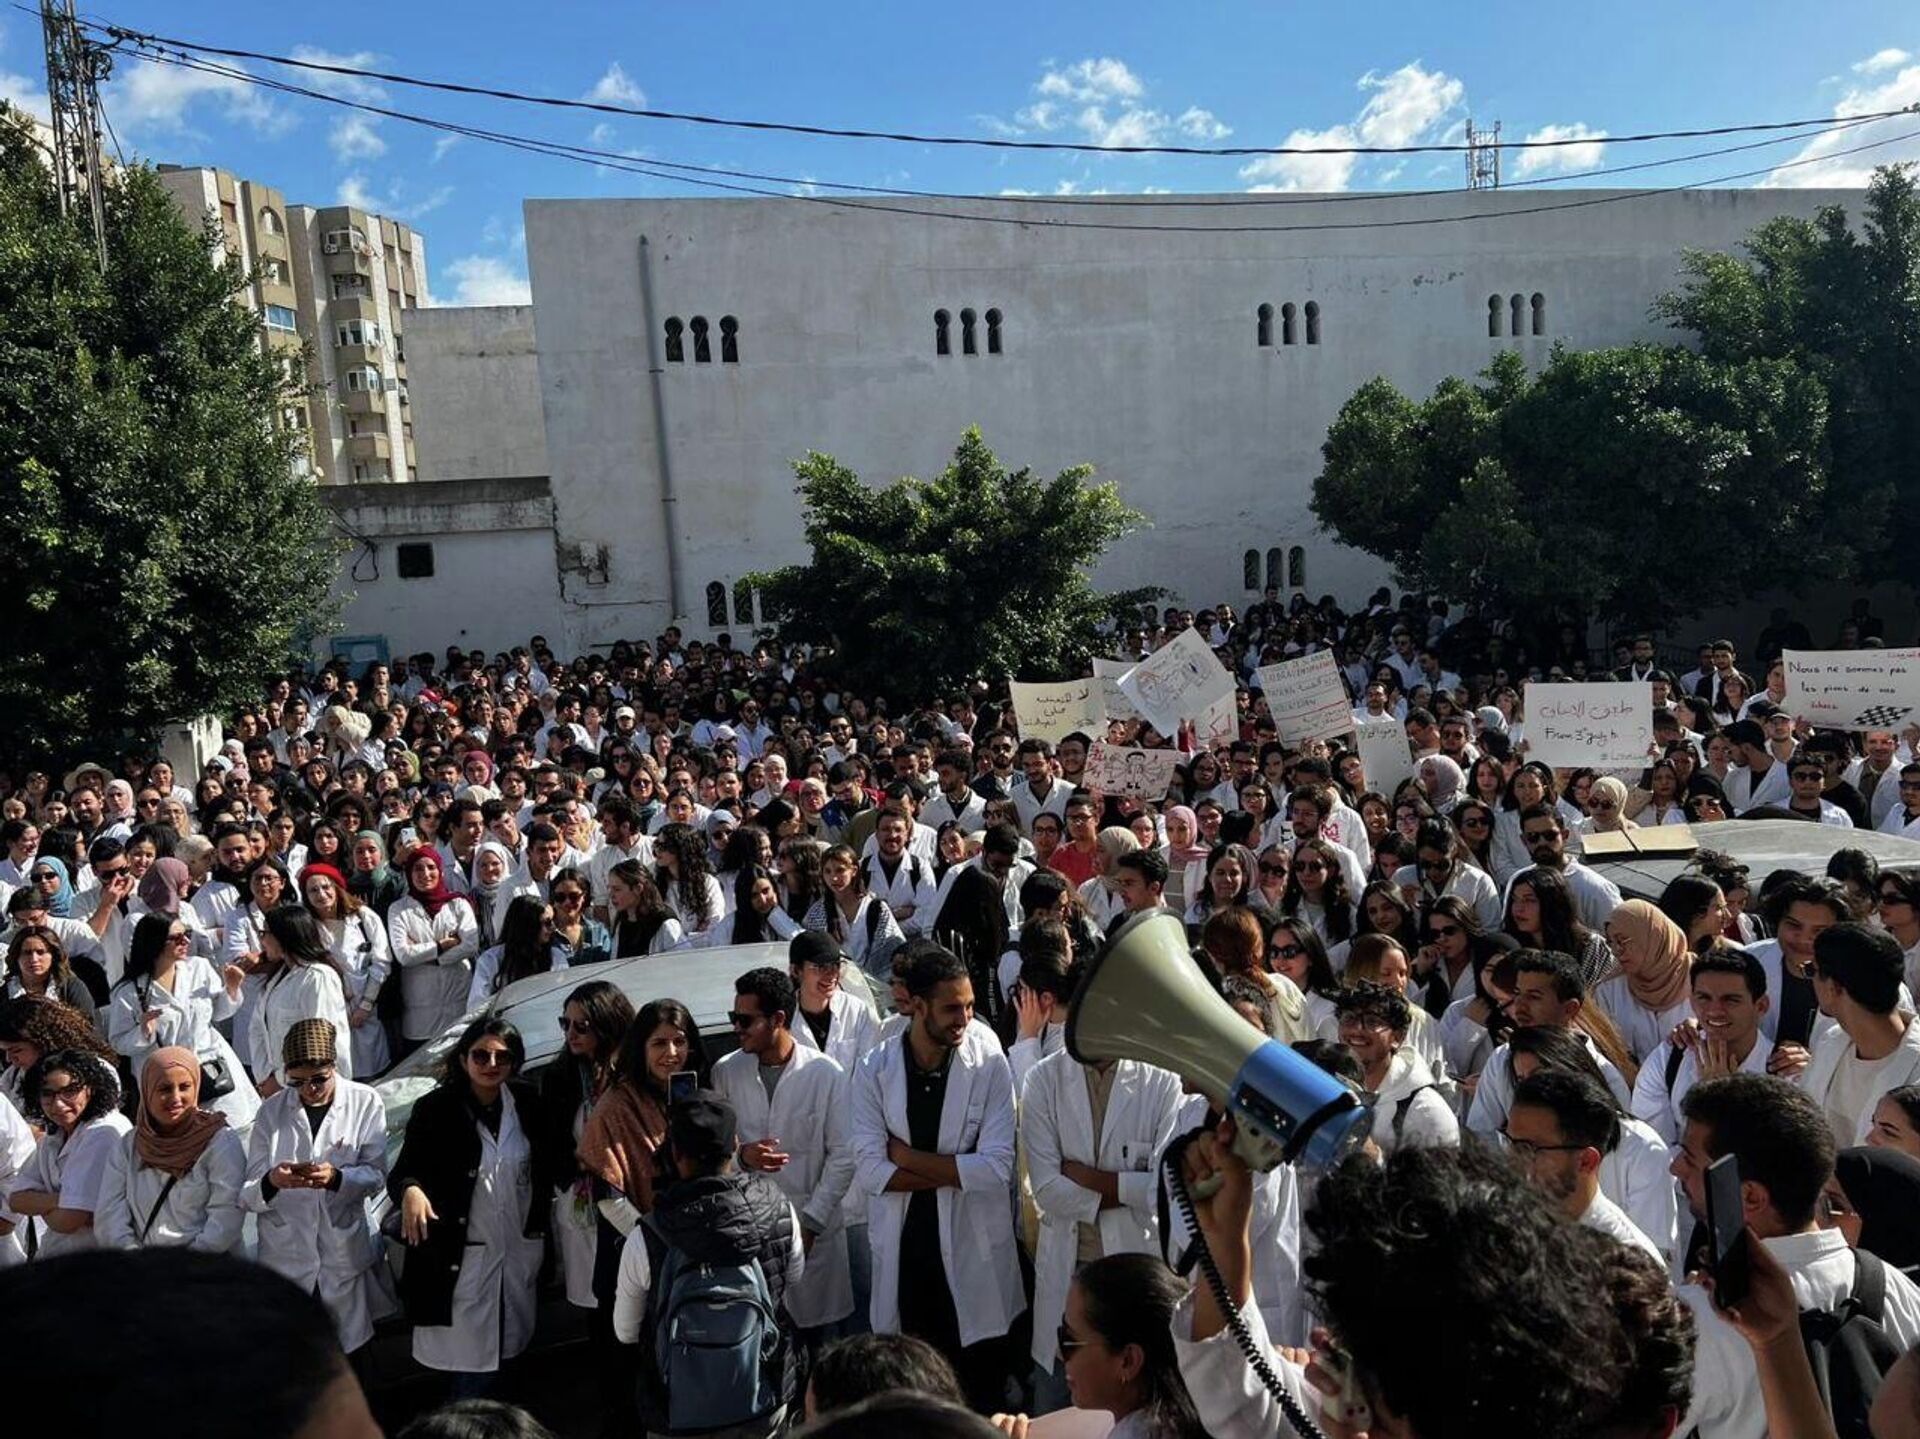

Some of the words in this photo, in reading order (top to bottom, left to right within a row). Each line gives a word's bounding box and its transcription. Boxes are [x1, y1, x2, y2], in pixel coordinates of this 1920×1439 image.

[1789, 662, 1820, 673] Nous
[1890, 665, 1907, 677] pas
[1801, 681, 1816, 692] les
[1545, 727, 1572, 740] From
